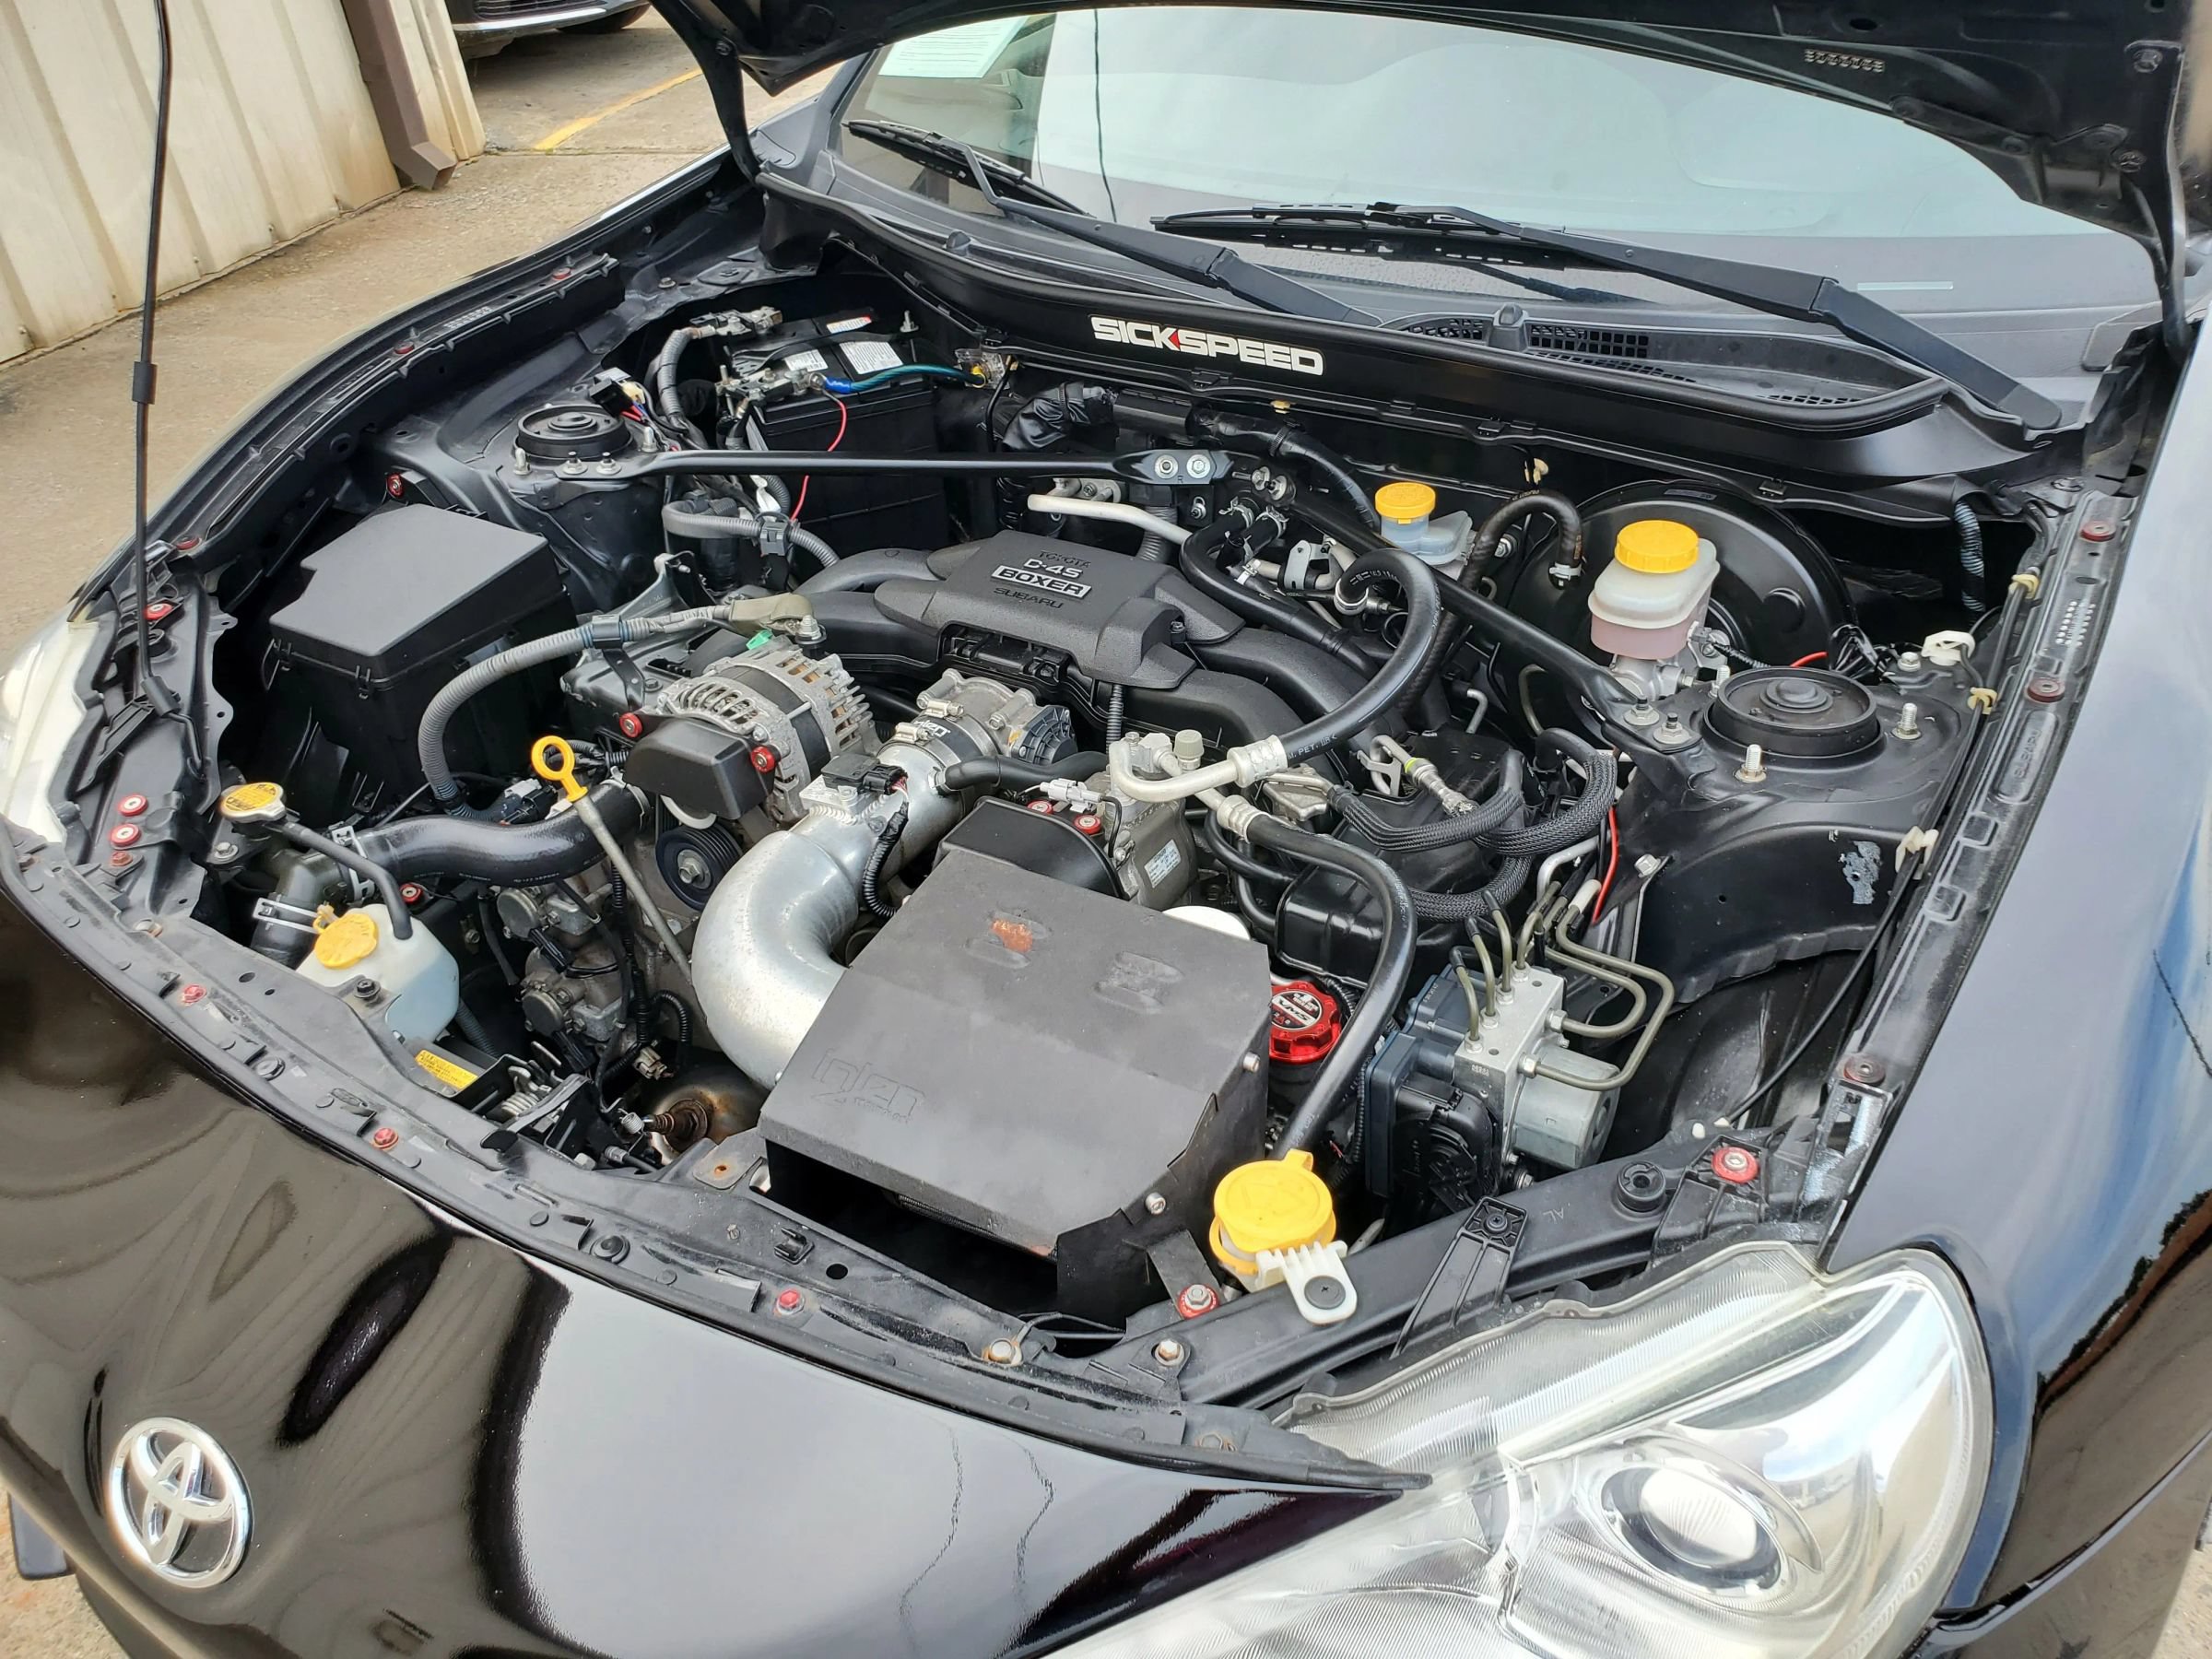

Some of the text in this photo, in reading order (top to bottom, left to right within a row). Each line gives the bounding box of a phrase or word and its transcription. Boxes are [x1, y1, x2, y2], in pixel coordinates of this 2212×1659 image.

[1091, 316, 1324, 376] SICKSPEED
[1023, 559, 1083, 579] D-4S
[1038, 550, 1092, 568] TOYOTA
[997, 568, 1085, 595] BOXER
[993, 587, 1065, 609] SUBARU
